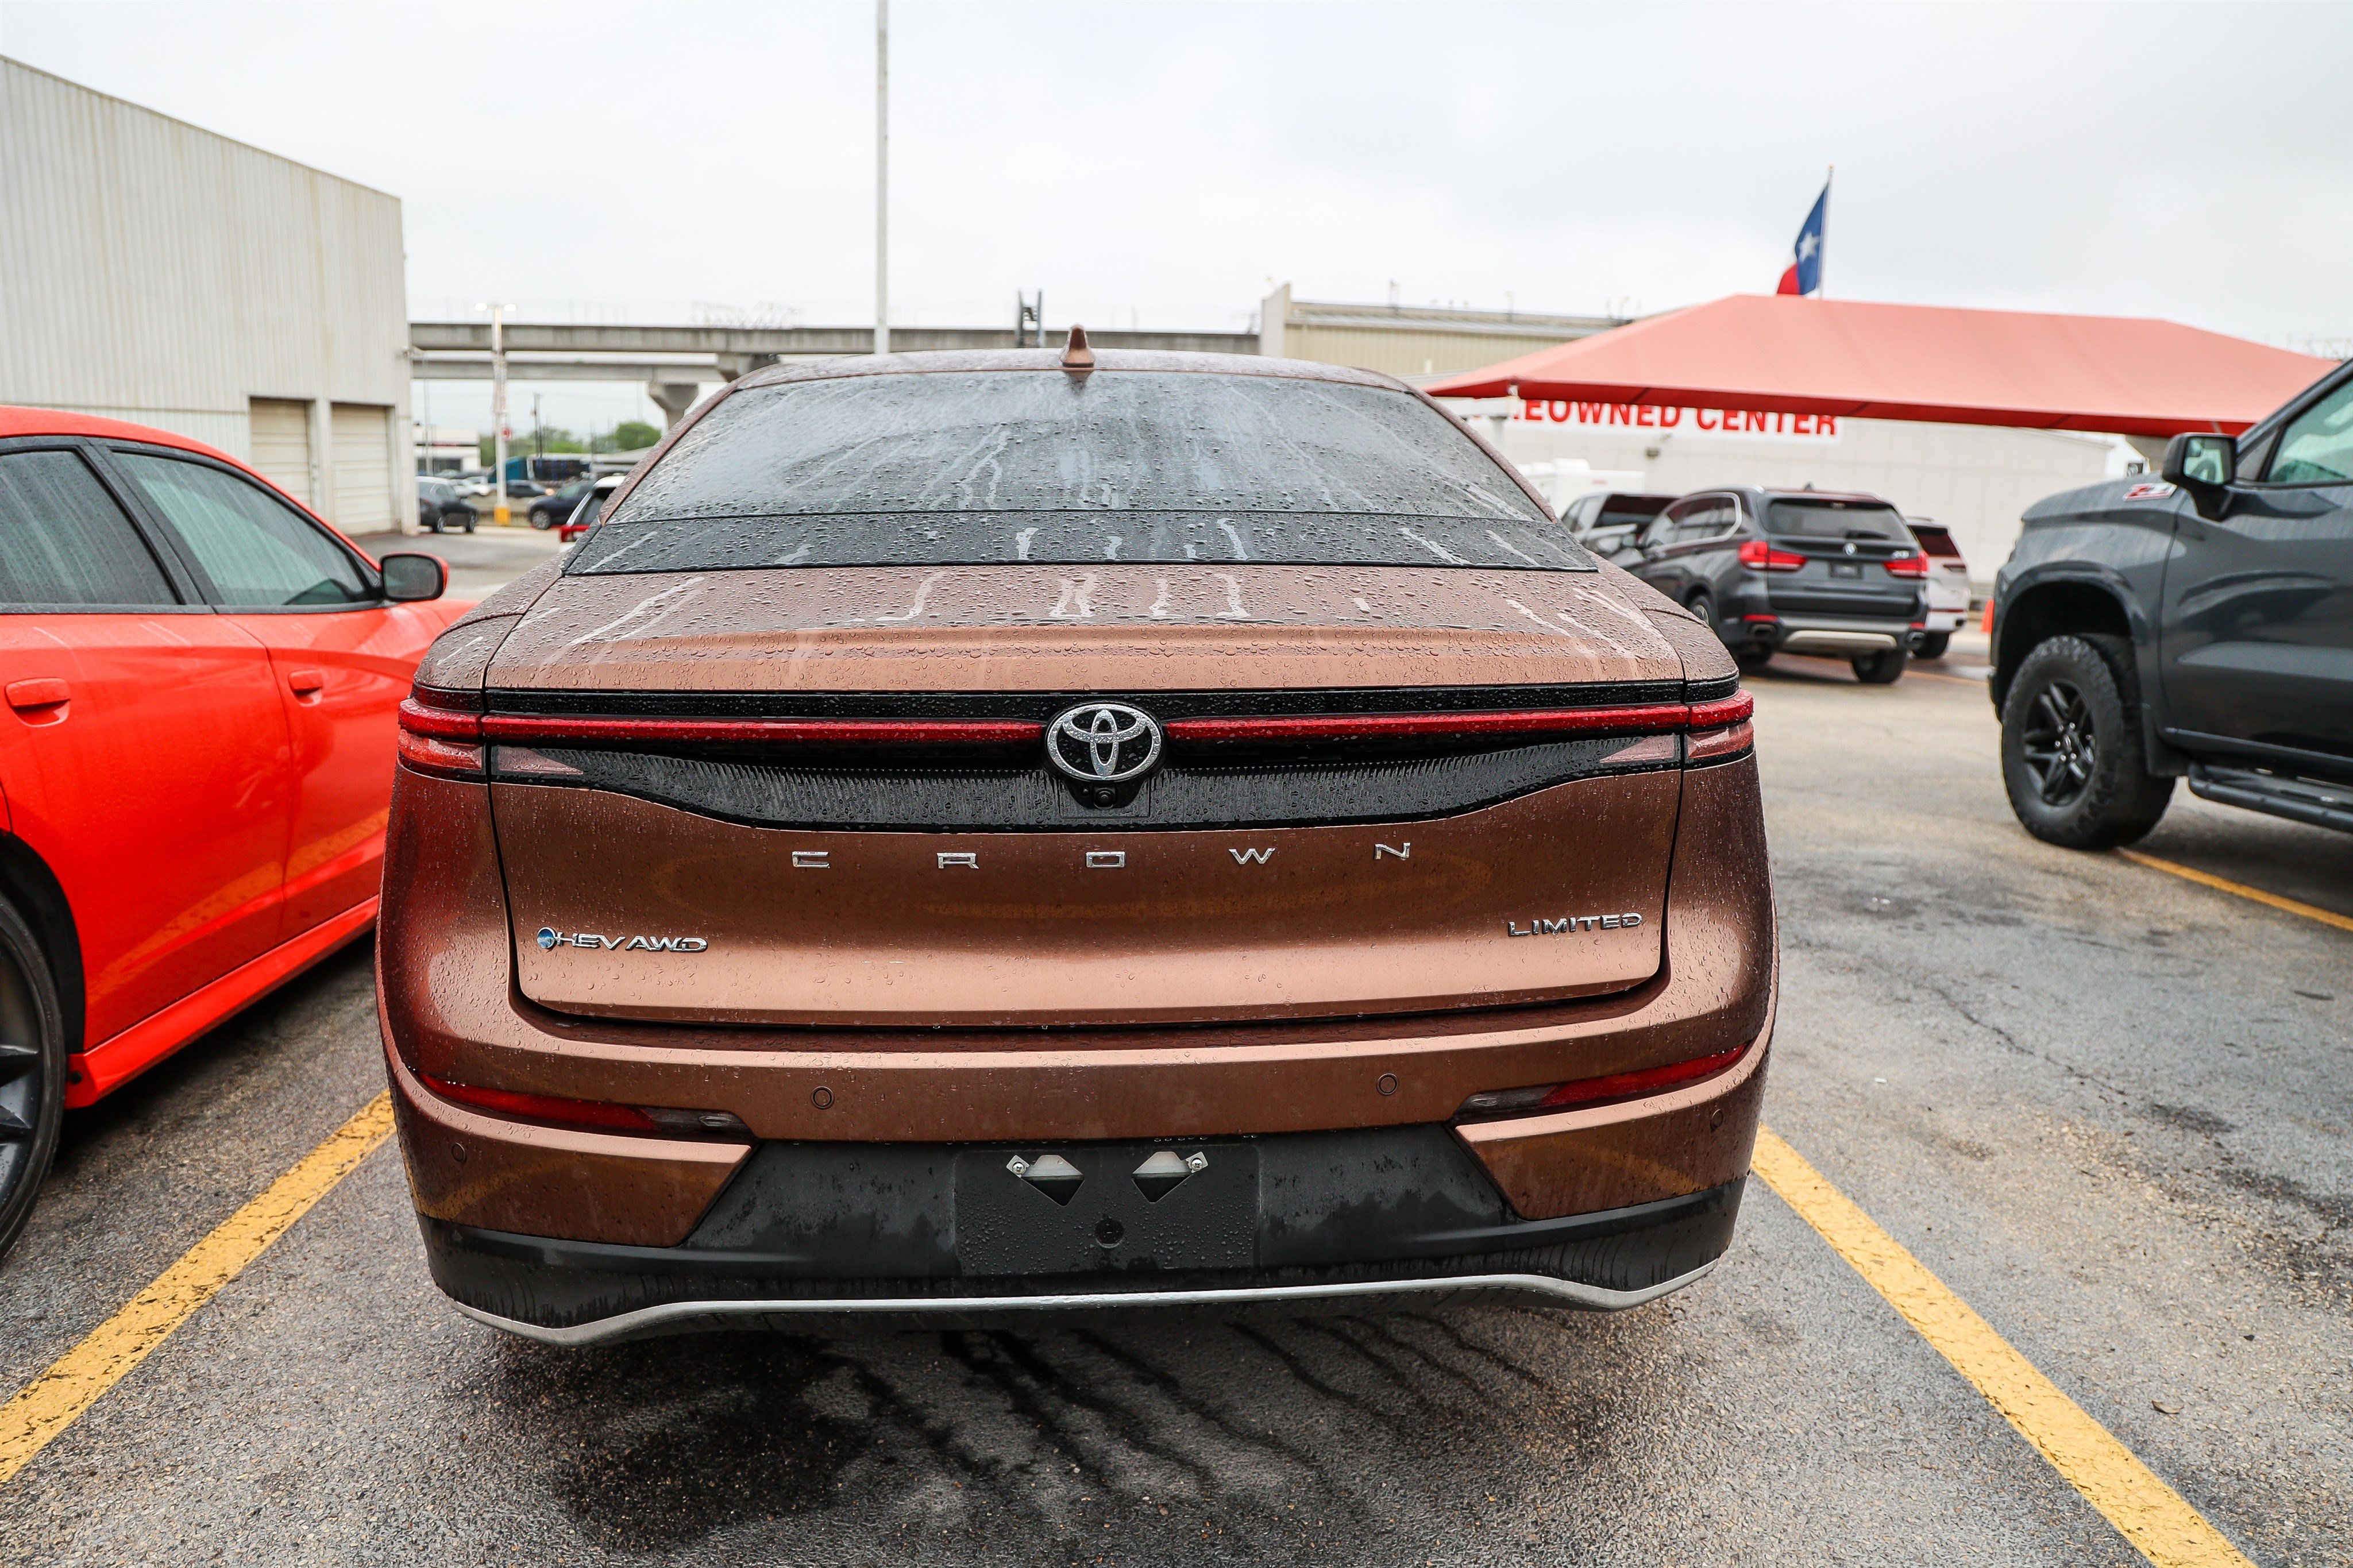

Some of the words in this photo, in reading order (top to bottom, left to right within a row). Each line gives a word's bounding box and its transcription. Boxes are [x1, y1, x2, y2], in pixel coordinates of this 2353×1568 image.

[1514, 399, 1681, 427] EOWNED
[1697, 408, 1835, 435] CENTER
[792, 841, 1411, 870] CROWN
[1508, 912, 1642, 937] LIMITED
